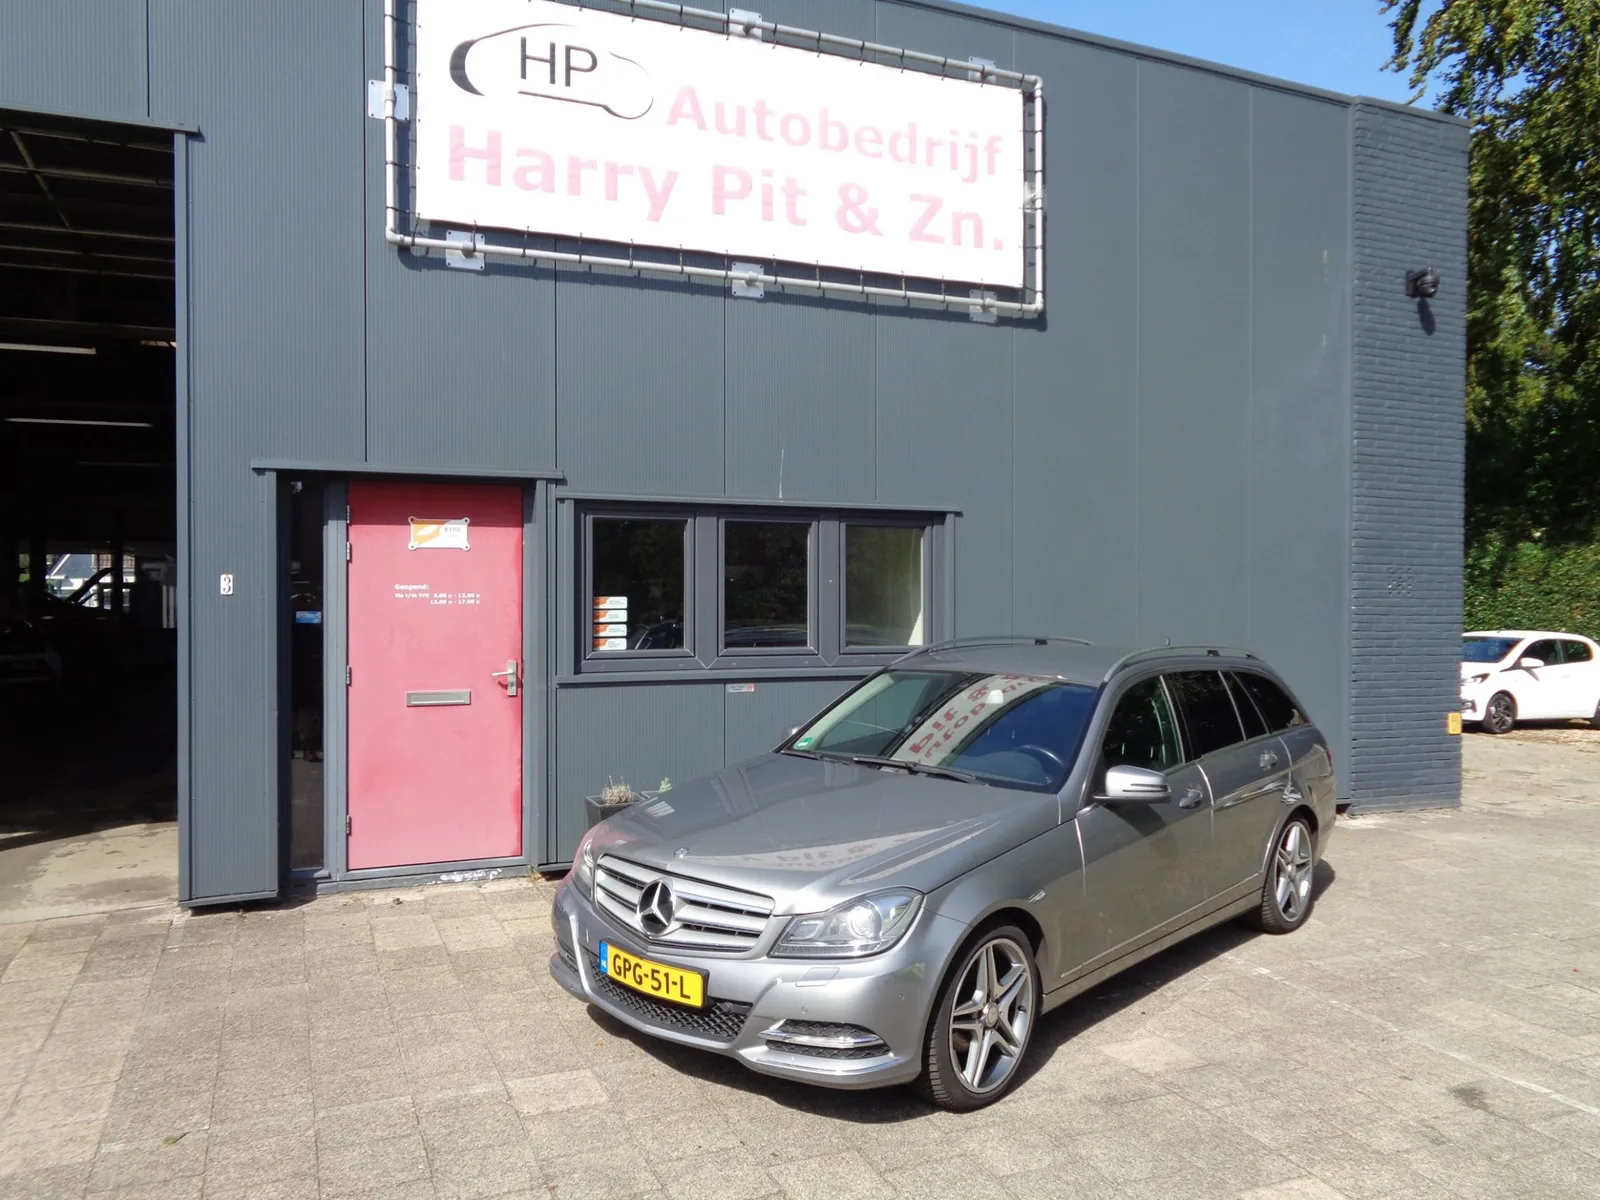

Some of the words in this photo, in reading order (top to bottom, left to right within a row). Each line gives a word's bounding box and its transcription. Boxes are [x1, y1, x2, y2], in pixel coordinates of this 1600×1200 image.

[520, 36, 598, 87] HP
[667, 86, 1002, 184] Autobedrijf
[448, 125, 680, 223] Harry
[712, 165, 808, 228] Pit
[836, 182, 883, 237] &
[909, 193, 1004, 251] Zn.
[223, 576, 231, 593] 3
[394, 583, 430, 591] Geopend:
[612, 953, 691, 1000] GPG-51-L
